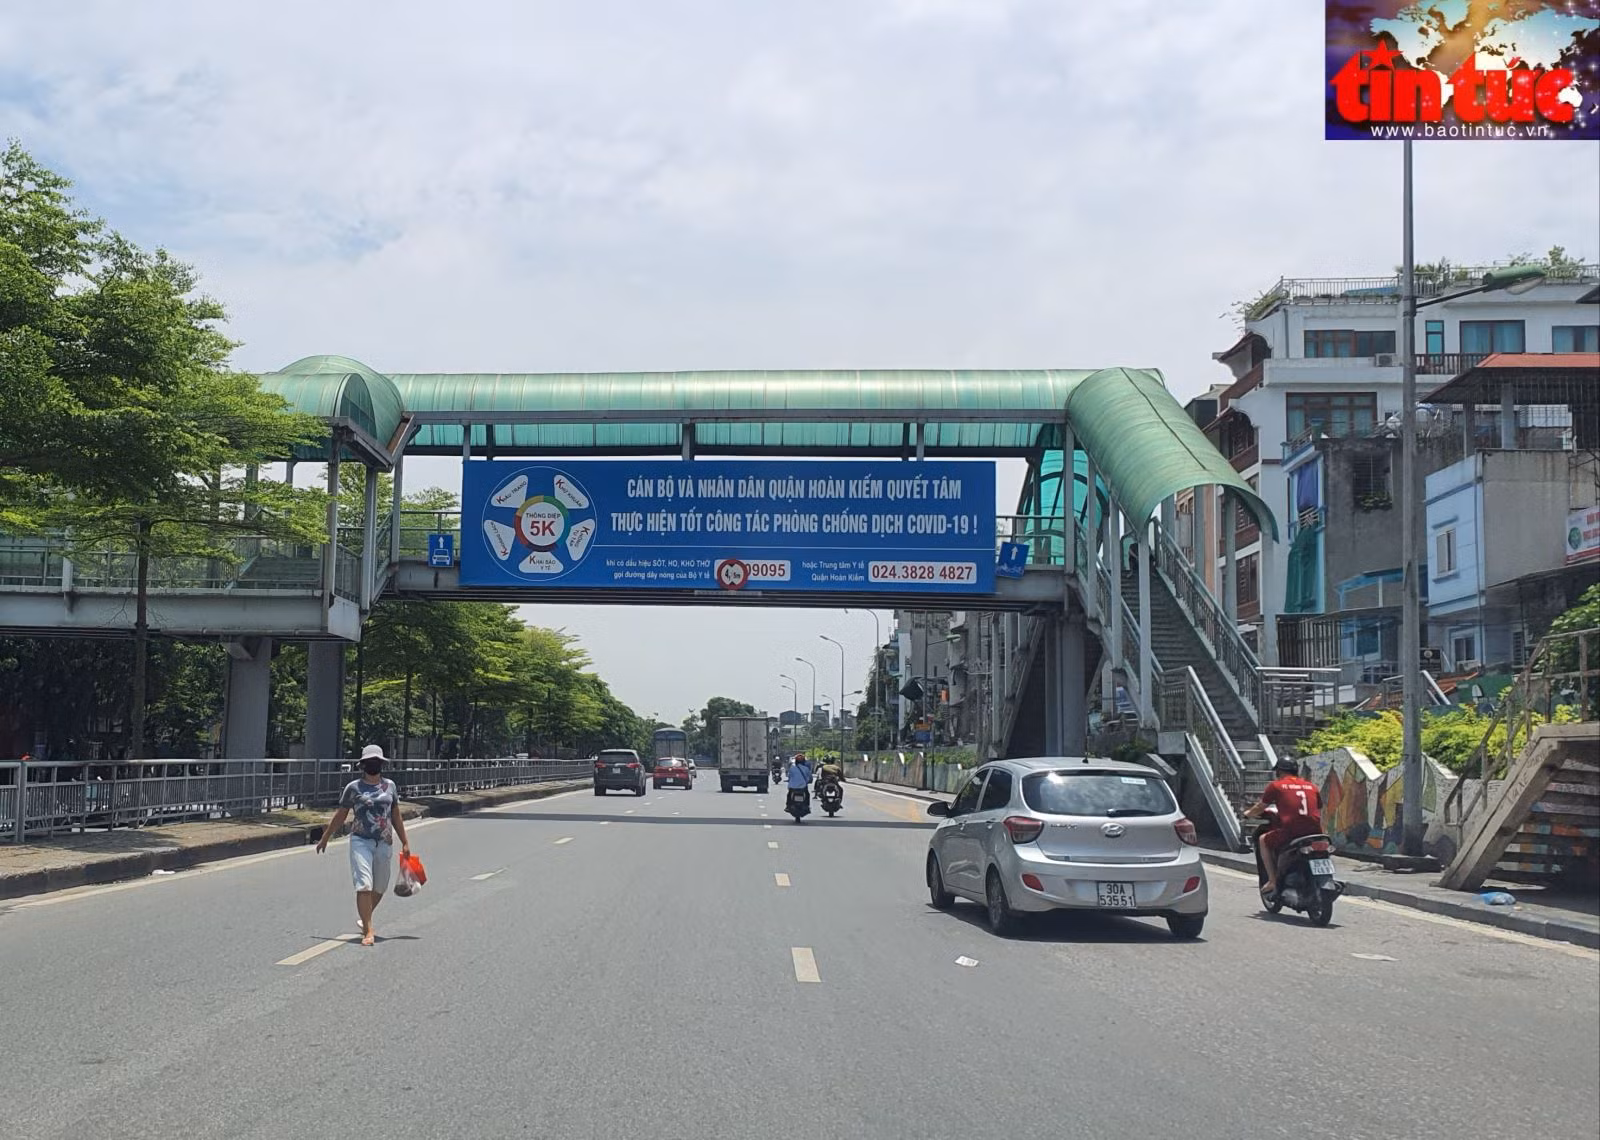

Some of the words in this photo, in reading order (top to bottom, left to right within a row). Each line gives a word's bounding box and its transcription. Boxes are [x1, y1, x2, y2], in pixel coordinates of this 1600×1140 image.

[627, 475, 653, 498] CÁN
[657, 475, 675, 502] BỘ
[678, 475, 694, 498] VÀ
[698, 475, 734, 498] NHÂN
[738, 475, 765, 498] DÂN
[769, 475, 805, 503] QUẬN
[808, 475, 845, 499] HOÀN
[849, 473, 883, 499] KIẾM
[887, 473, 929, 501] QUYẾT
[932, 475, 962, 499] TÂM
[526, 511, 546, 519] THÔNG
[611, 511, 643, 536] THỰC
[647, 508, 677, 536] HIỆN
[680, 506, 703, 532] TỐT
[706, 509, 742, 532] CÔNG
[745, 509, 770, 532] TÁC
[773, 509, 819, 533] PHÒNG
[822, 507, 868, 533] CHỐNG
[871, 514, 903, 538] DỊCH
[907, 514, 969, 534] COVID-19
[973, 515, 978, 534] !
[530, 520, 556, 536] 5K
[606, 559, 616, 567] khi
[819, 561, 838, 571] Trung
[852, 561, 857, 569] Y
[688, 571, 698, 581] Bộ
[699, 571, 703, 579] Y
[872, 564, 935, 580] 024.3828
[939, 565, 973, 581] 4827
[1296, 790, 1308, 815] 3
[1106, 883, 1126, 895] 30A
